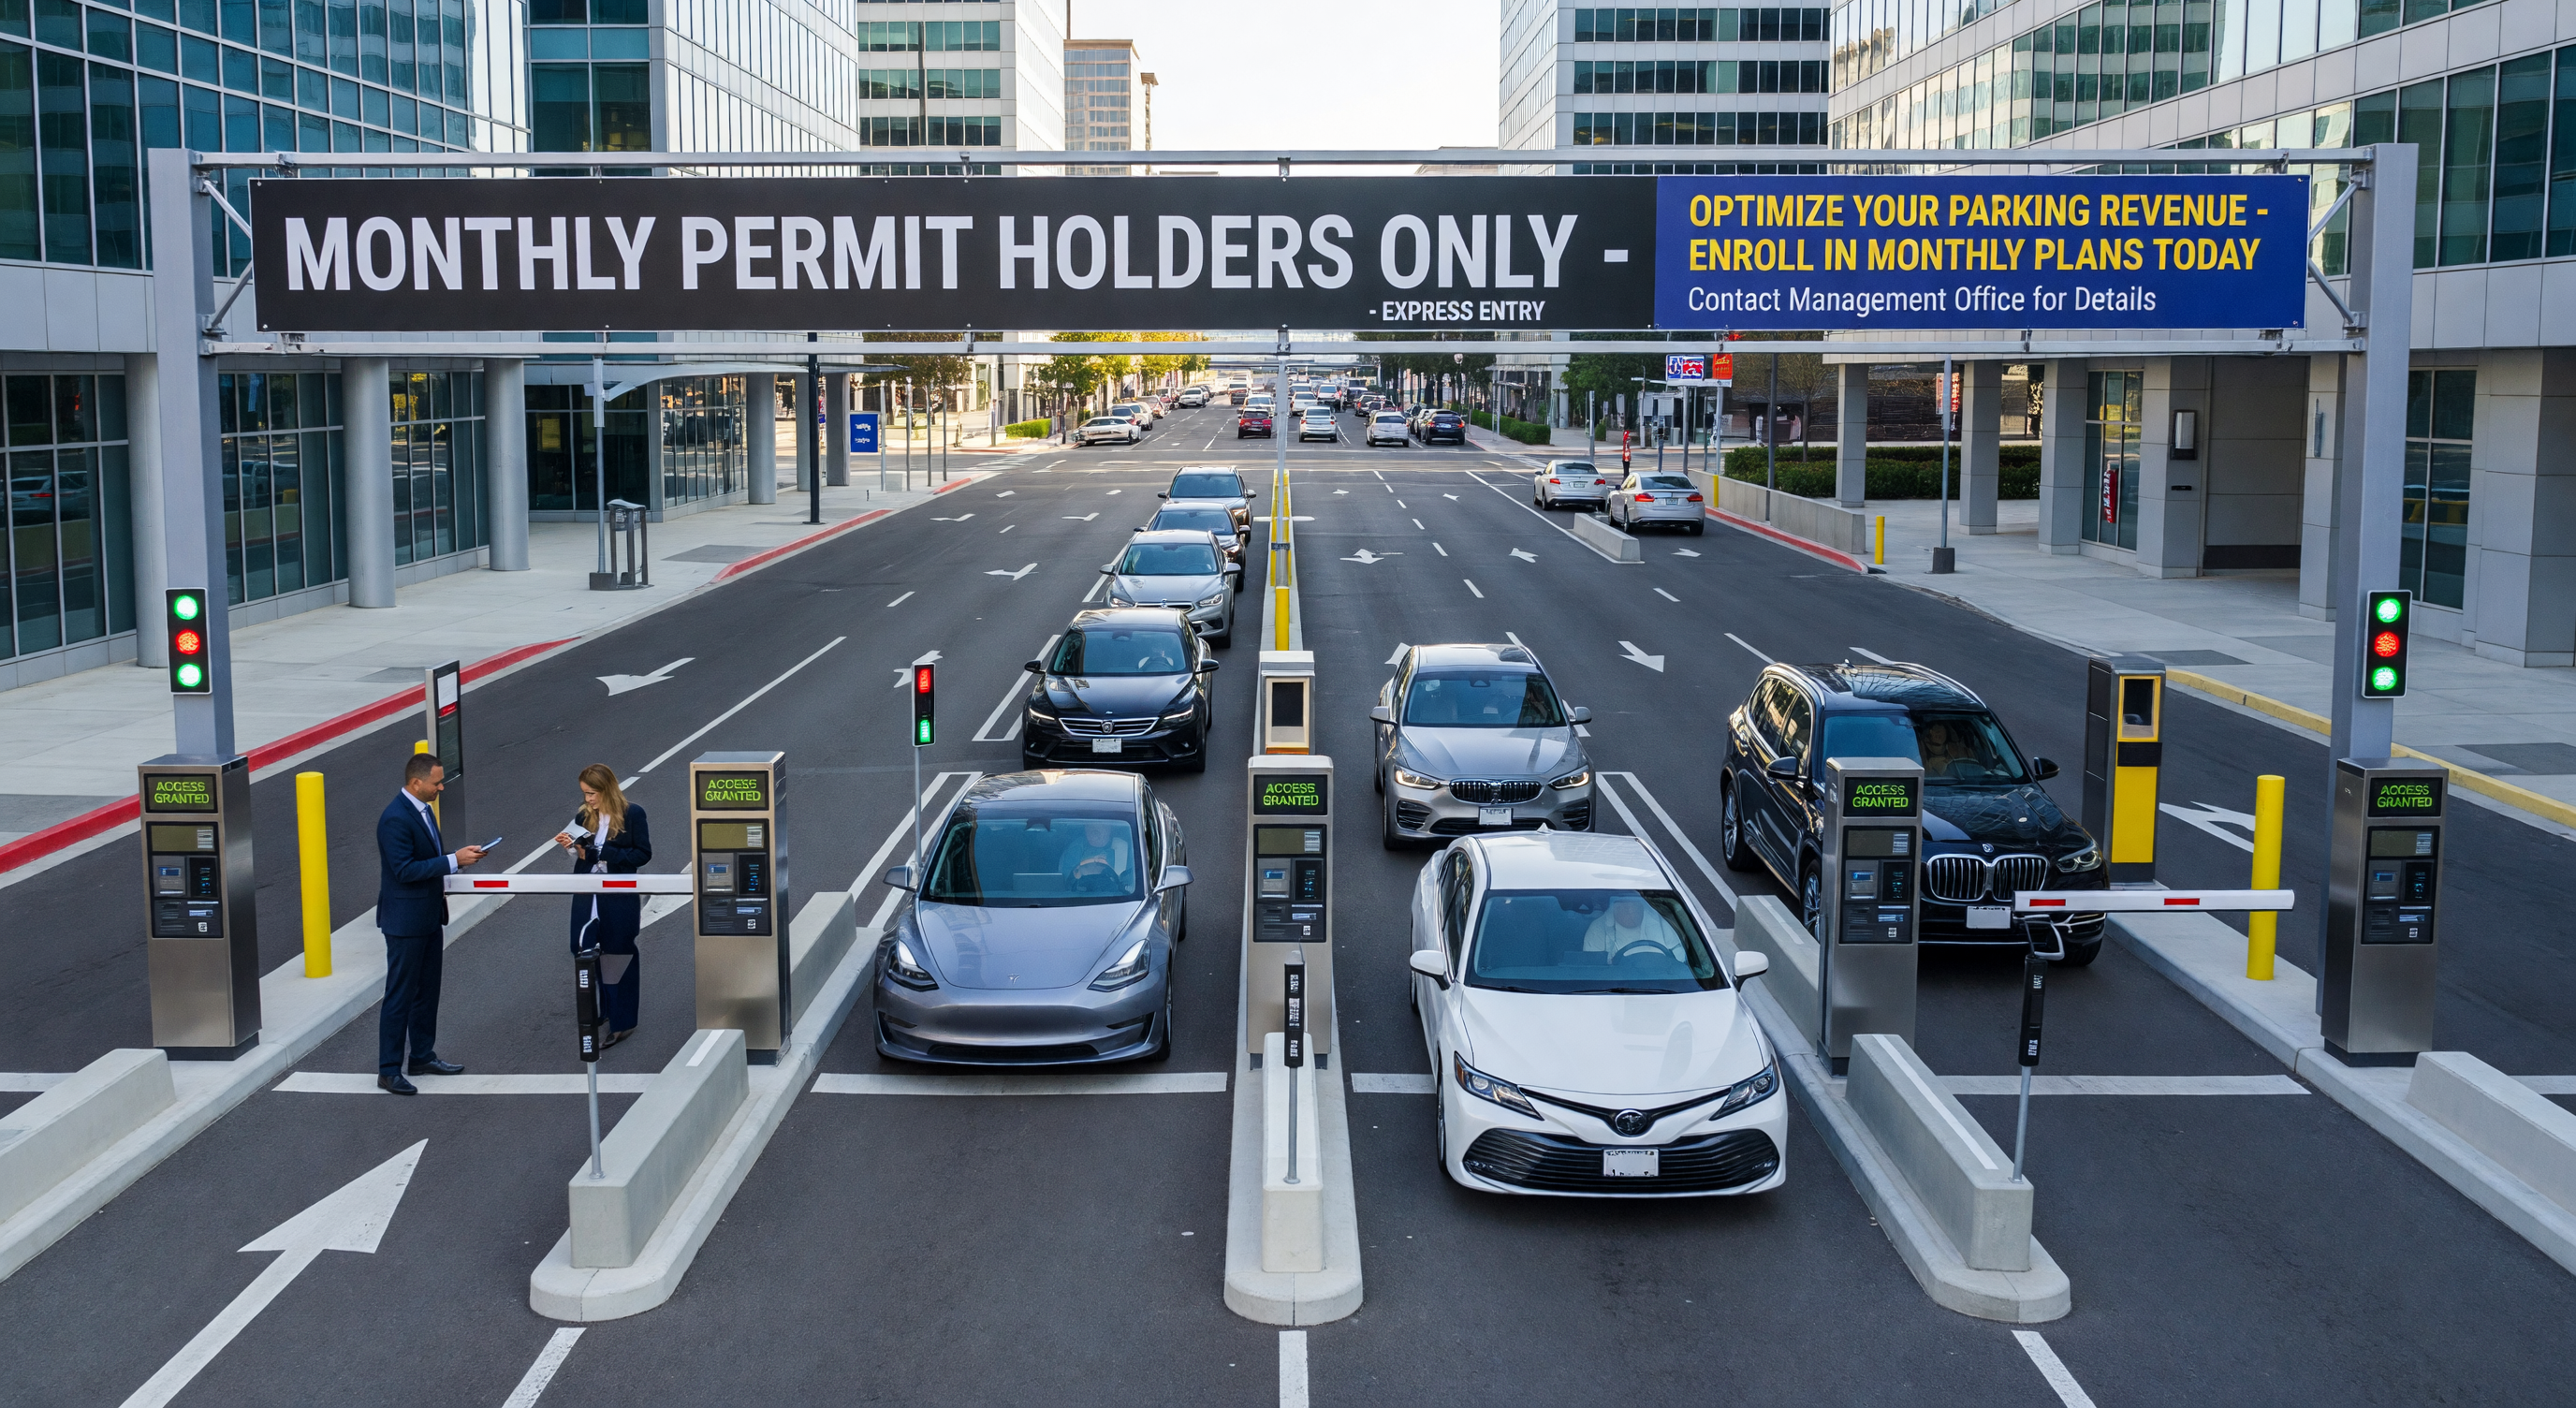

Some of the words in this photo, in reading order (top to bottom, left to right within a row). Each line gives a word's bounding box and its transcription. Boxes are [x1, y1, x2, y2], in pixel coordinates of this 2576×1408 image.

[1690, 195, 1844, 227] OPTIMIZE
[1853, 195, 1939, 227] YOUR
[1950, 195, 2090, 227] PARKING
[2100, 195, 2247, 226] REVENUE
[285, 216, 656, 291] MONTHLY
[681, 216, 973, 290] PERMIT
[999, 213, 1354, 290] HOLDERS
[1380, 213, 1578, 289] ONLY
[1689, 239, 1814, 271] ENROLL
[1824, 239, 1857, 271] IN
[1867, 239, 2025, 271] MONTHLY
[2034, 239, 2144, 271] PLANS
[2153, 239, 2261, 271] TODAY
[1383, 301, 1473, 321] EXPRESS
[1479, 301, 1545, 321] ENTRY
[1689, 286, 1781, 312] Contact
[1789, 286, 1947, 318] Management
[1954, 285, 2025, 312] Office
[2033, 285, 2068, 311] for
[2075, 286, 2157, 312] Details
[154, 792, 210, 804] GRANTED
[1852, 796, 1910, 808] GRANTED
[2377, 796, 2433, 808] GRANTED
